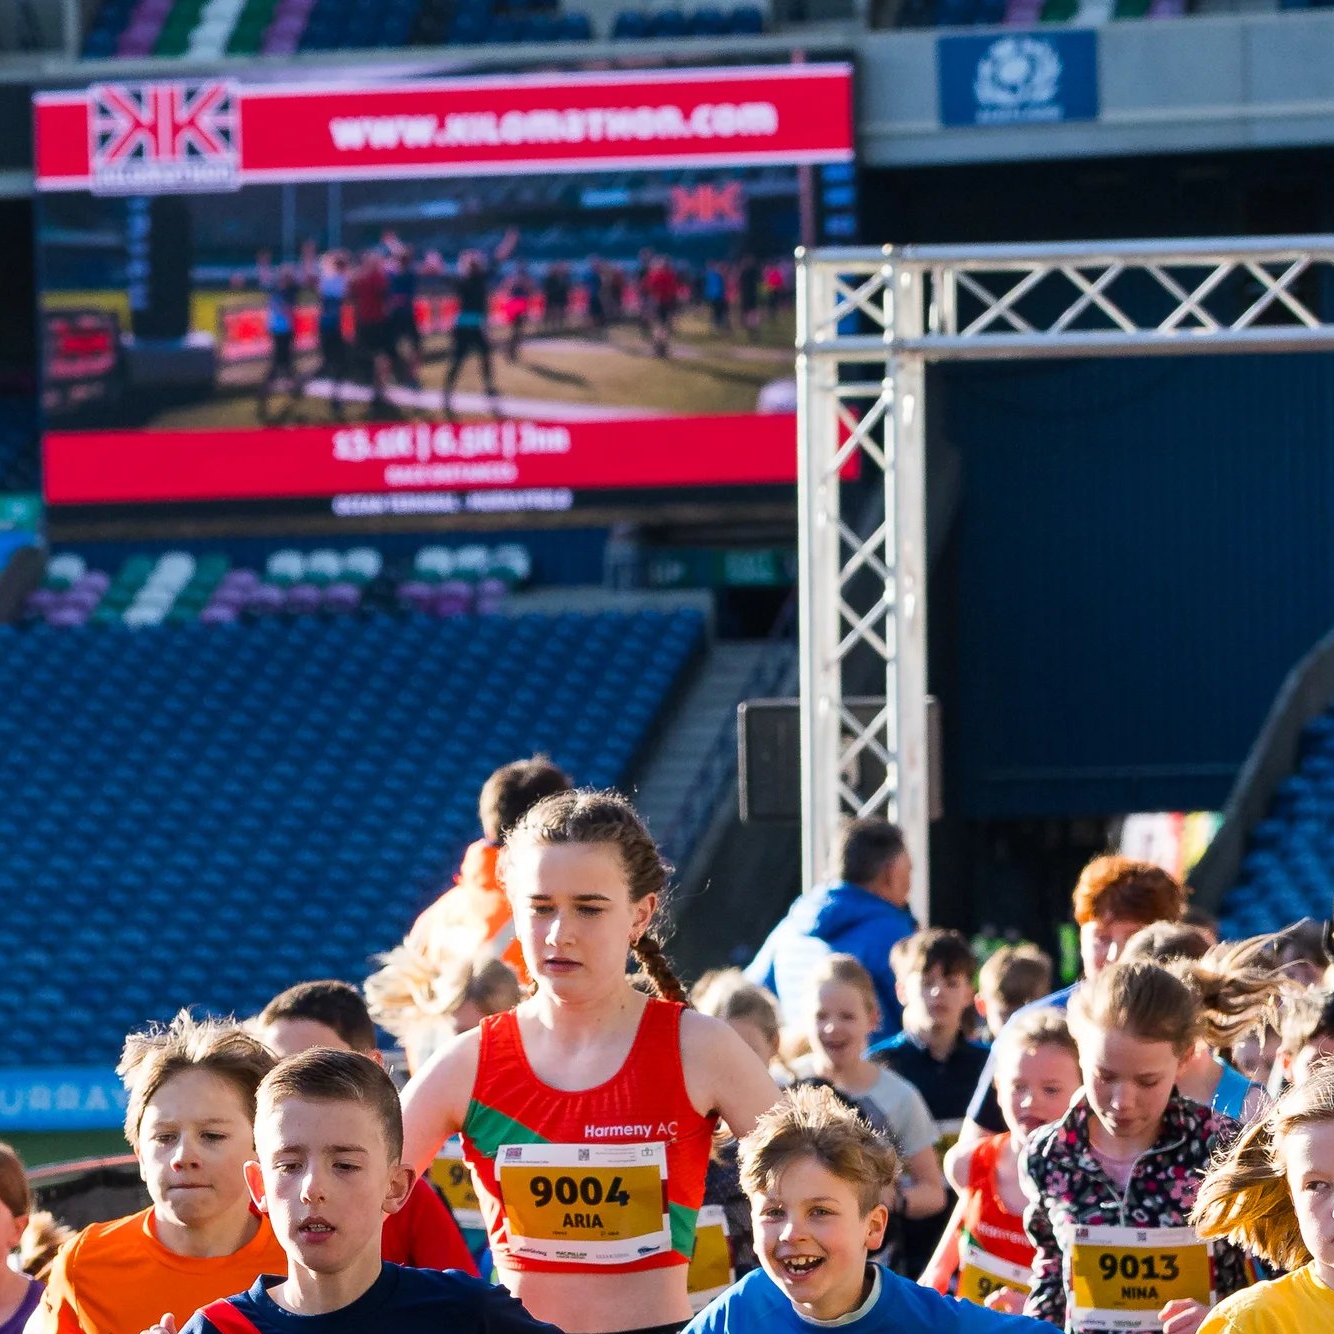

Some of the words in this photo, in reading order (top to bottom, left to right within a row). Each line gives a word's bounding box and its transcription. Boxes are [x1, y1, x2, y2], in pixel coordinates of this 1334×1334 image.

[584, 1123, 652, 1139] Harmeny
[656, 1121, 679, 1137] AC
[529, 1175, 630, 1207] 9004
[562, 1213, 604, 1228] ARIA
[1099, 1253, 1179, 1280] 9013
[1122, 1286, 1158, 1299] NINA
